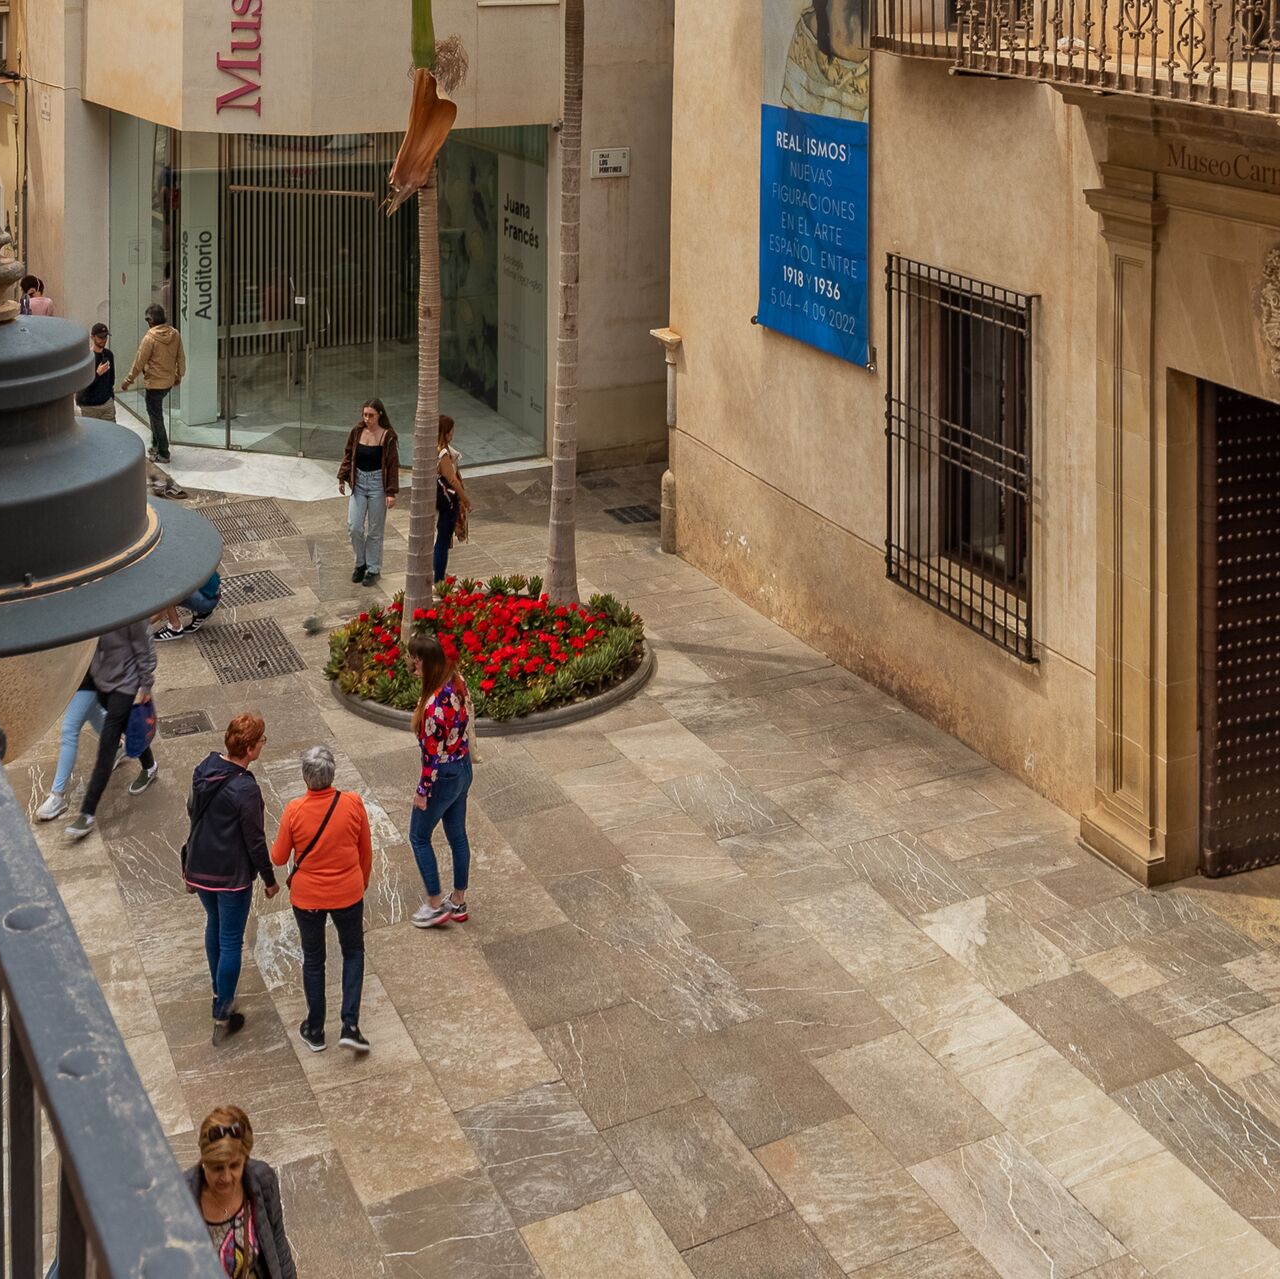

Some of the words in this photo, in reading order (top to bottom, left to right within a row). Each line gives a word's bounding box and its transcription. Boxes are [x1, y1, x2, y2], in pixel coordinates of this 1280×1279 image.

[790, 161, 833, 188] NUEVAS
[1168, 143, 1231, 177] Museo
[504, 193, 530, 219] Juana
[772, 182, 856, 221] FIGURACIONES
[503, 218, 539, 249] Francés
[781, 211, 794, 230] EN
[798, 216, 810, 236] EL
[814, 222, 842, 246] ARTE
[769, 234, 816, 266] ESPAÑOL
[820, 251, 857, 279] ENTRE
[195, 231, 212, 320] Auditorio
[783, 265, 804, 288] 1918
[806, 272, 812, 290] Y
[814, 276, 840, 300] 1936
